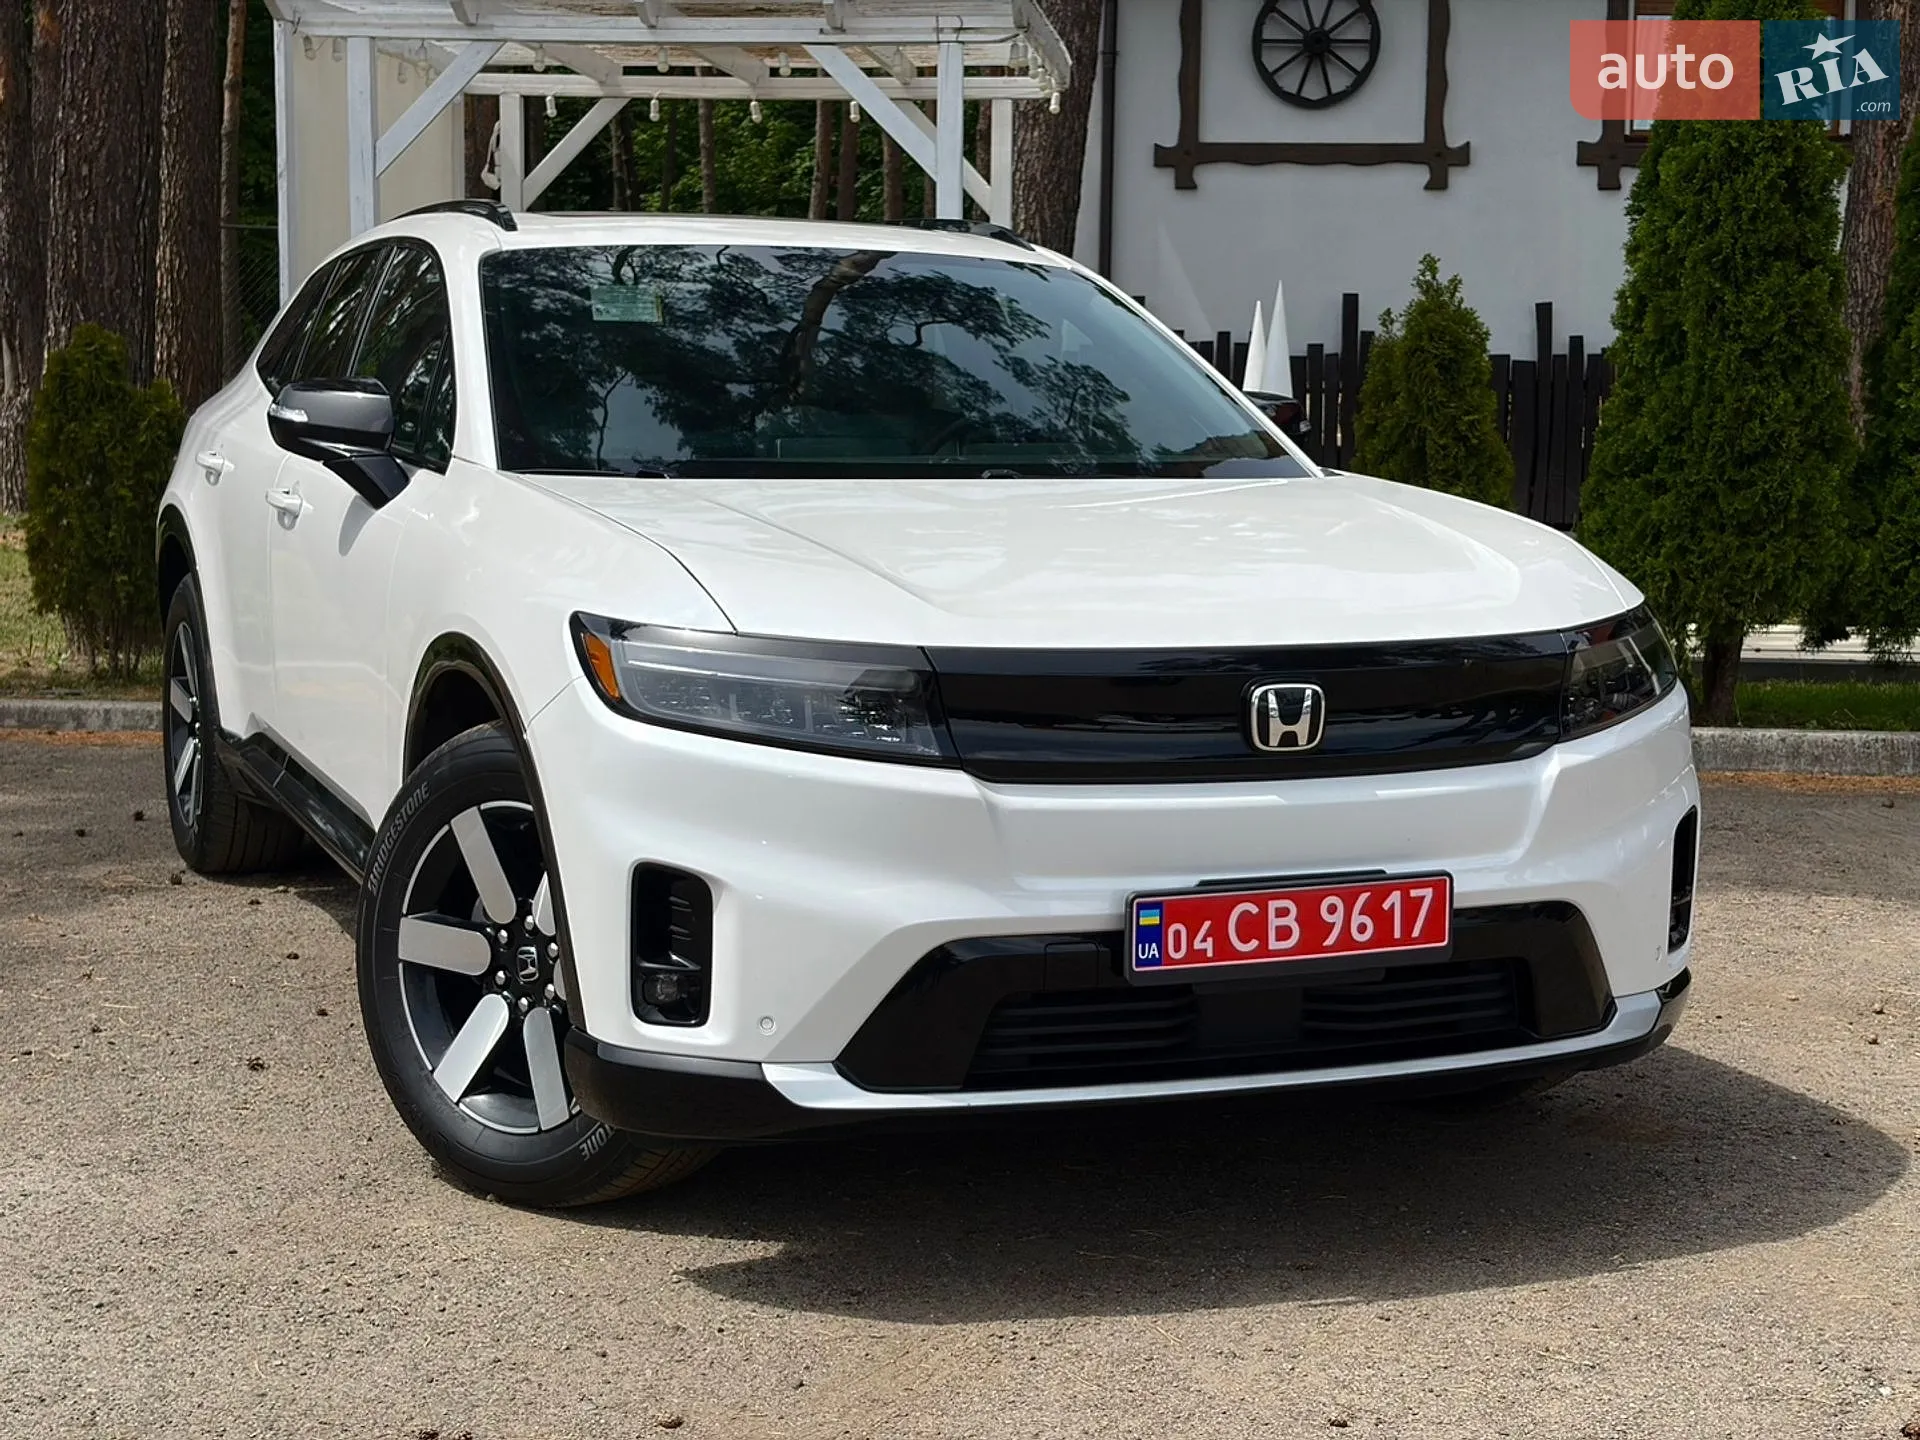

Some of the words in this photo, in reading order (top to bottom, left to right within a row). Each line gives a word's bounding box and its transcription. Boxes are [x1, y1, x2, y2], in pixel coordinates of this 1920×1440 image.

[367, 781, 431, 897] BRIDGESTONE
[1138, 943, 1159, 960] UA
[1167, 920, 1215, 960] 04
[1227, 899, 1301, 952] CB
[1319, 886, 1434, 947] 9617
